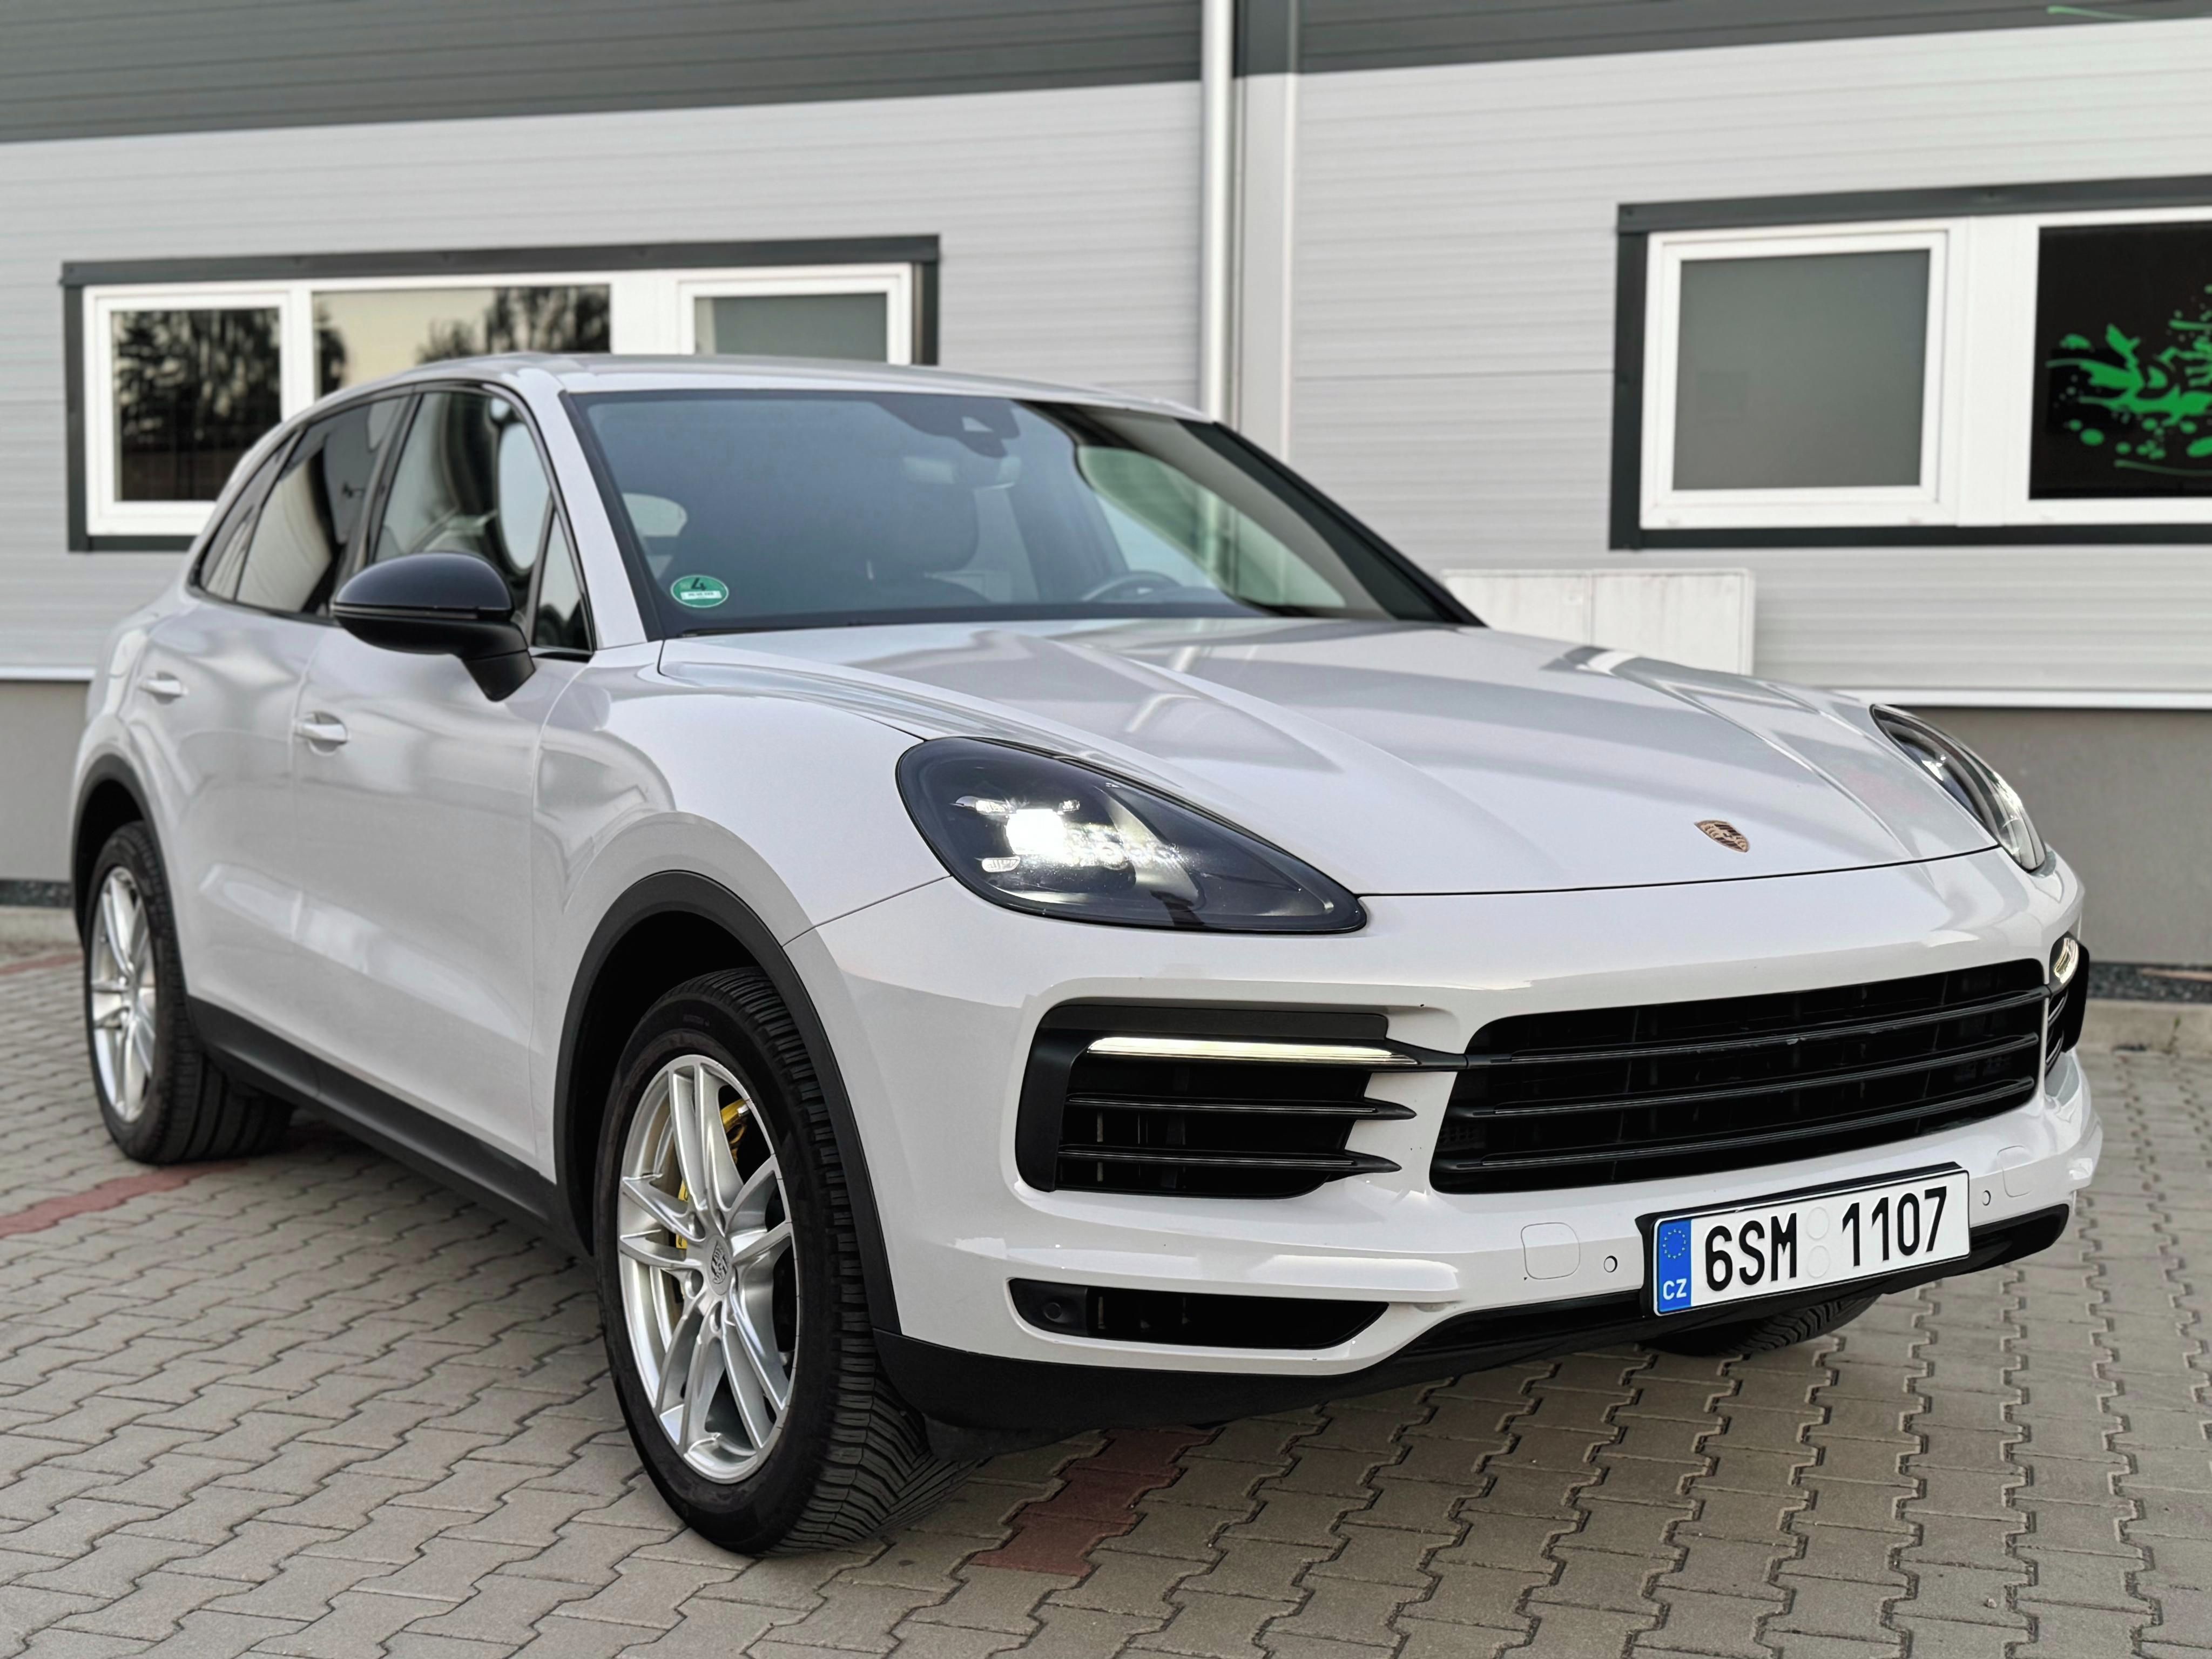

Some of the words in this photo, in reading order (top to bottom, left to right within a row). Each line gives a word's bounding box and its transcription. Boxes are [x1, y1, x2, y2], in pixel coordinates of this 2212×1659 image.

[691, 577, 706, 591] 4
[1704, 1212, 1797, 1292] 6SM
[1842, 1186, 1947, 1267] 1107
[1663, 1278, 1688, 1300] CZ
